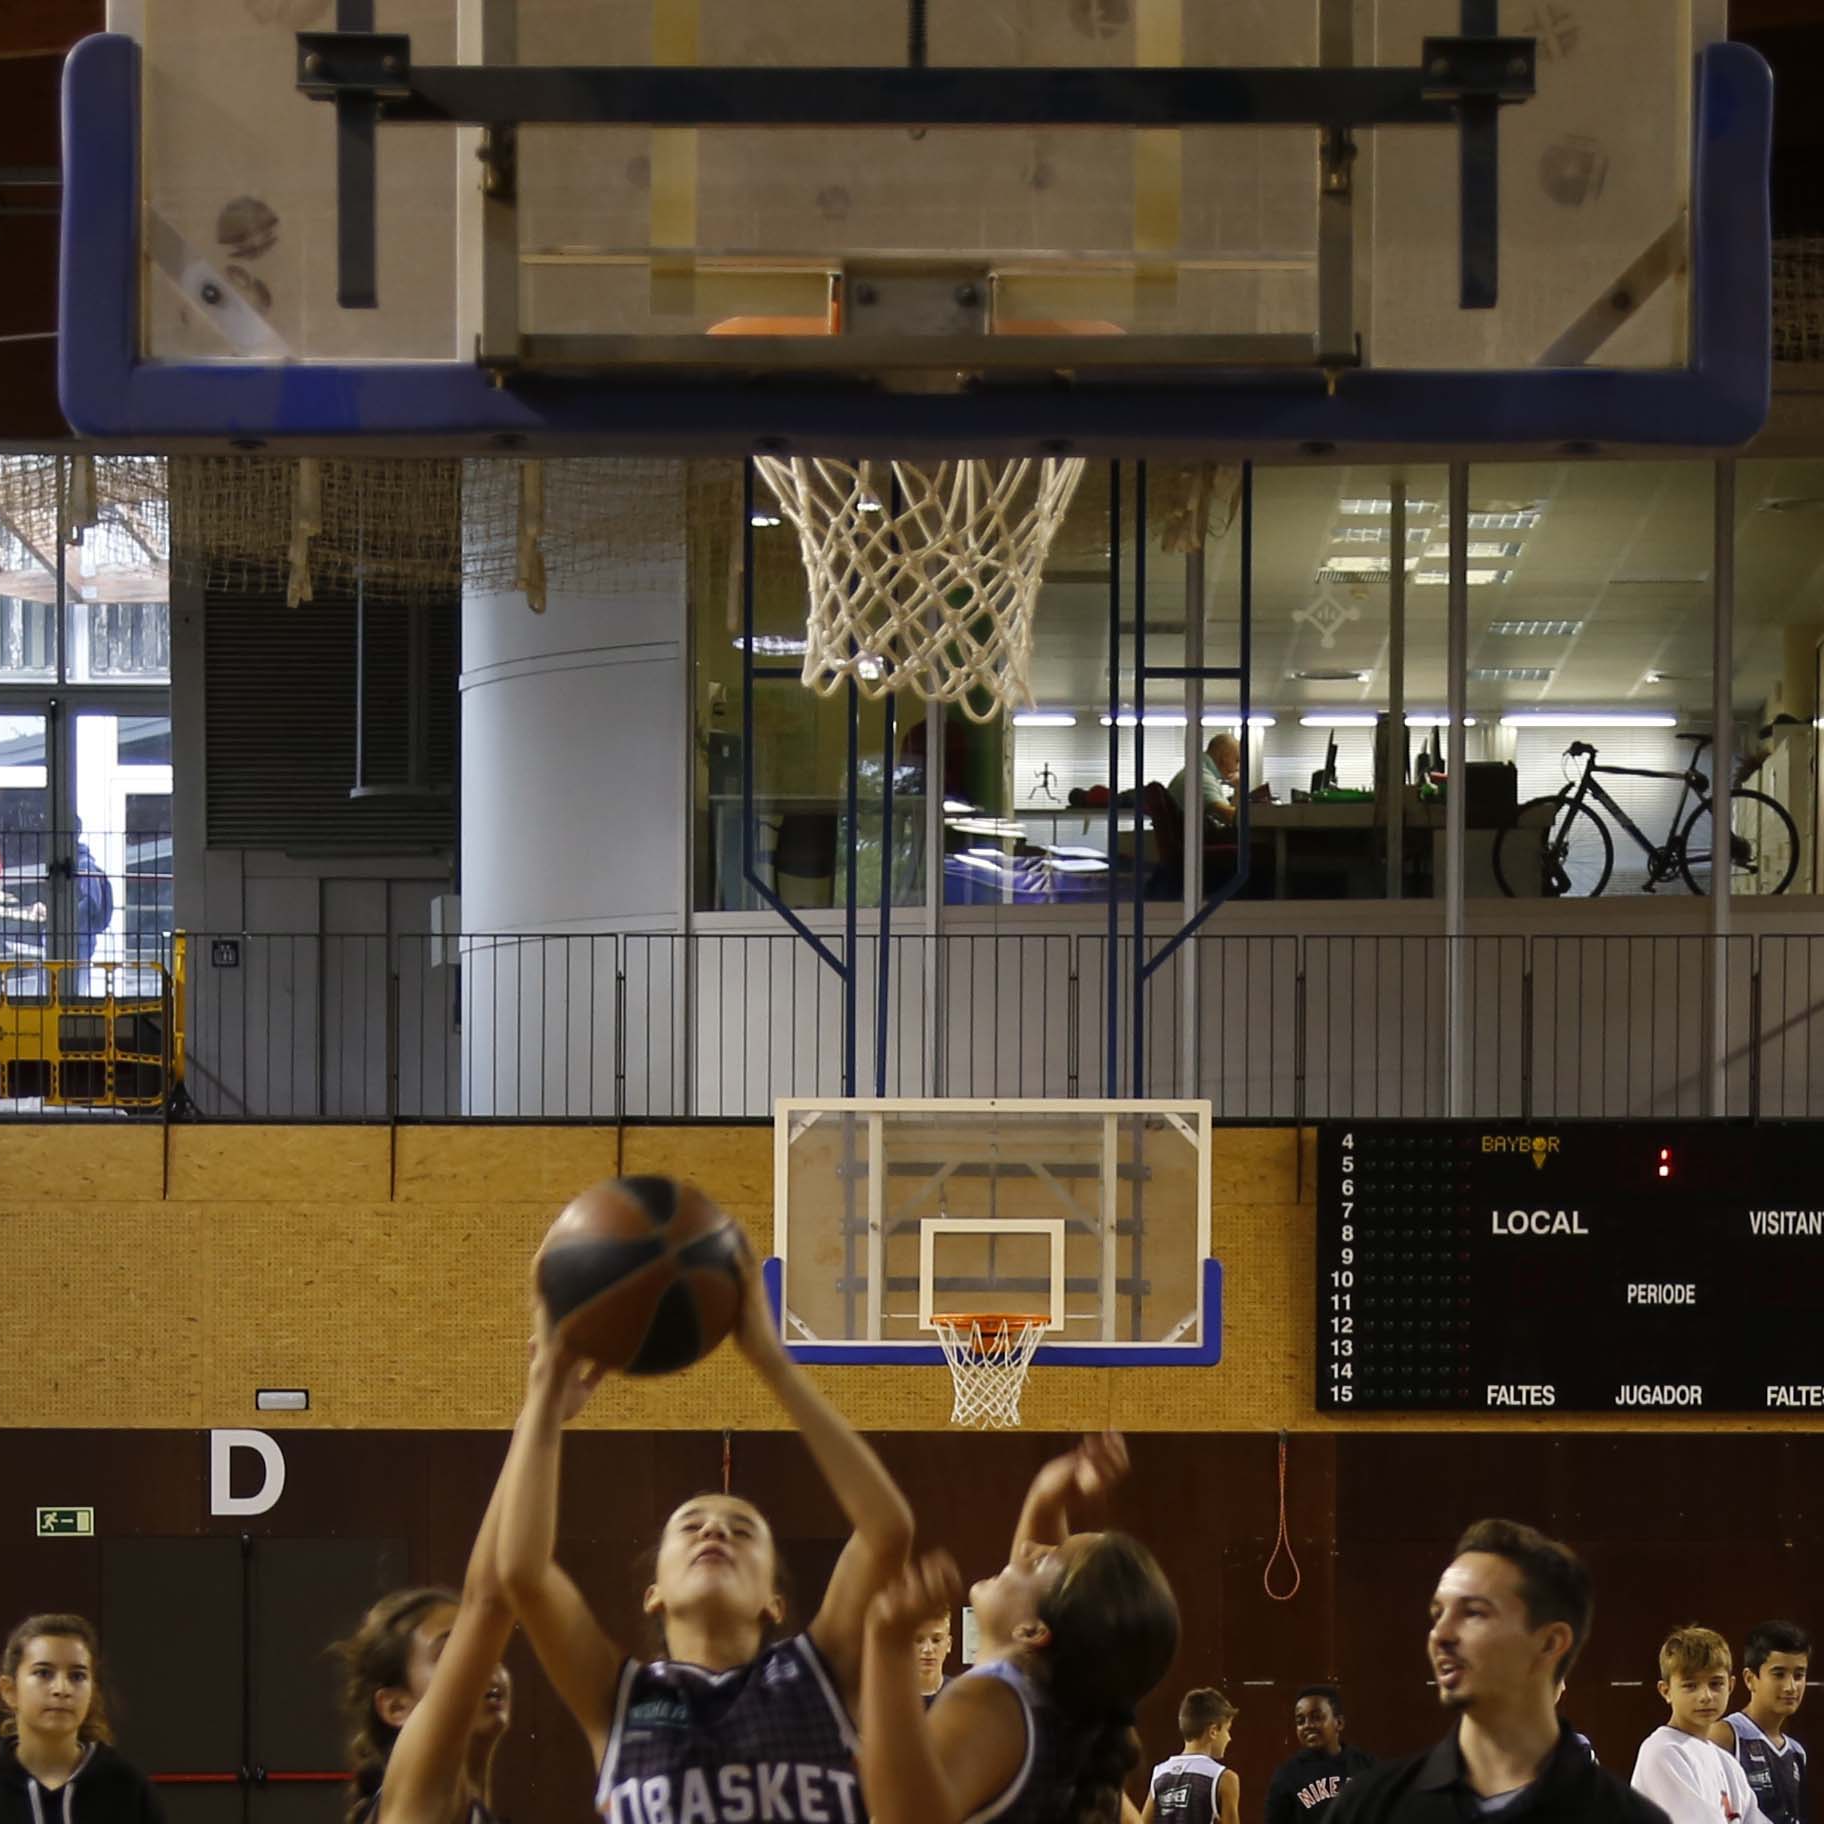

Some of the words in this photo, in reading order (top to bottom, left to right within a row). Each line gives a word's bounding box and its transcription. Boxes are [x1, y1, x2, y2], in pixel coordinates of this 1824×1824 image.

[1342, 1134, 1353, 1149] 4
[1342, 1157, 1353, 1172] 5
[1342, 1179, 1353, 1195] 6
[1342, 1203, 1353, 1218] 7
[1492, 1211, 1589, 1235] LOCAL
[1342, 1225, 1353, 1241] 8
[1342, 1248, 1353, 1264] 9
[1331, 1271, 1353, 1287] 10
[1331, 1294, 1351, 1310] 11
[1627, 1284, 1696, 1305] PERIODE
[1331, 1317, 1353, 1333] 12
[1331, 1340, 1353, 1356] 13
[1331, 1363, 1353, 1379] 14
[1331, 1385, 1353, 1402] 15
[1487, 1385, 1555, 1406] FALTES
[1615, 1385, 1703, 1406] JUGADOR
[211, 1429, 286, 1516] D
[1297, 1776, 1341, 1809] NIKE
